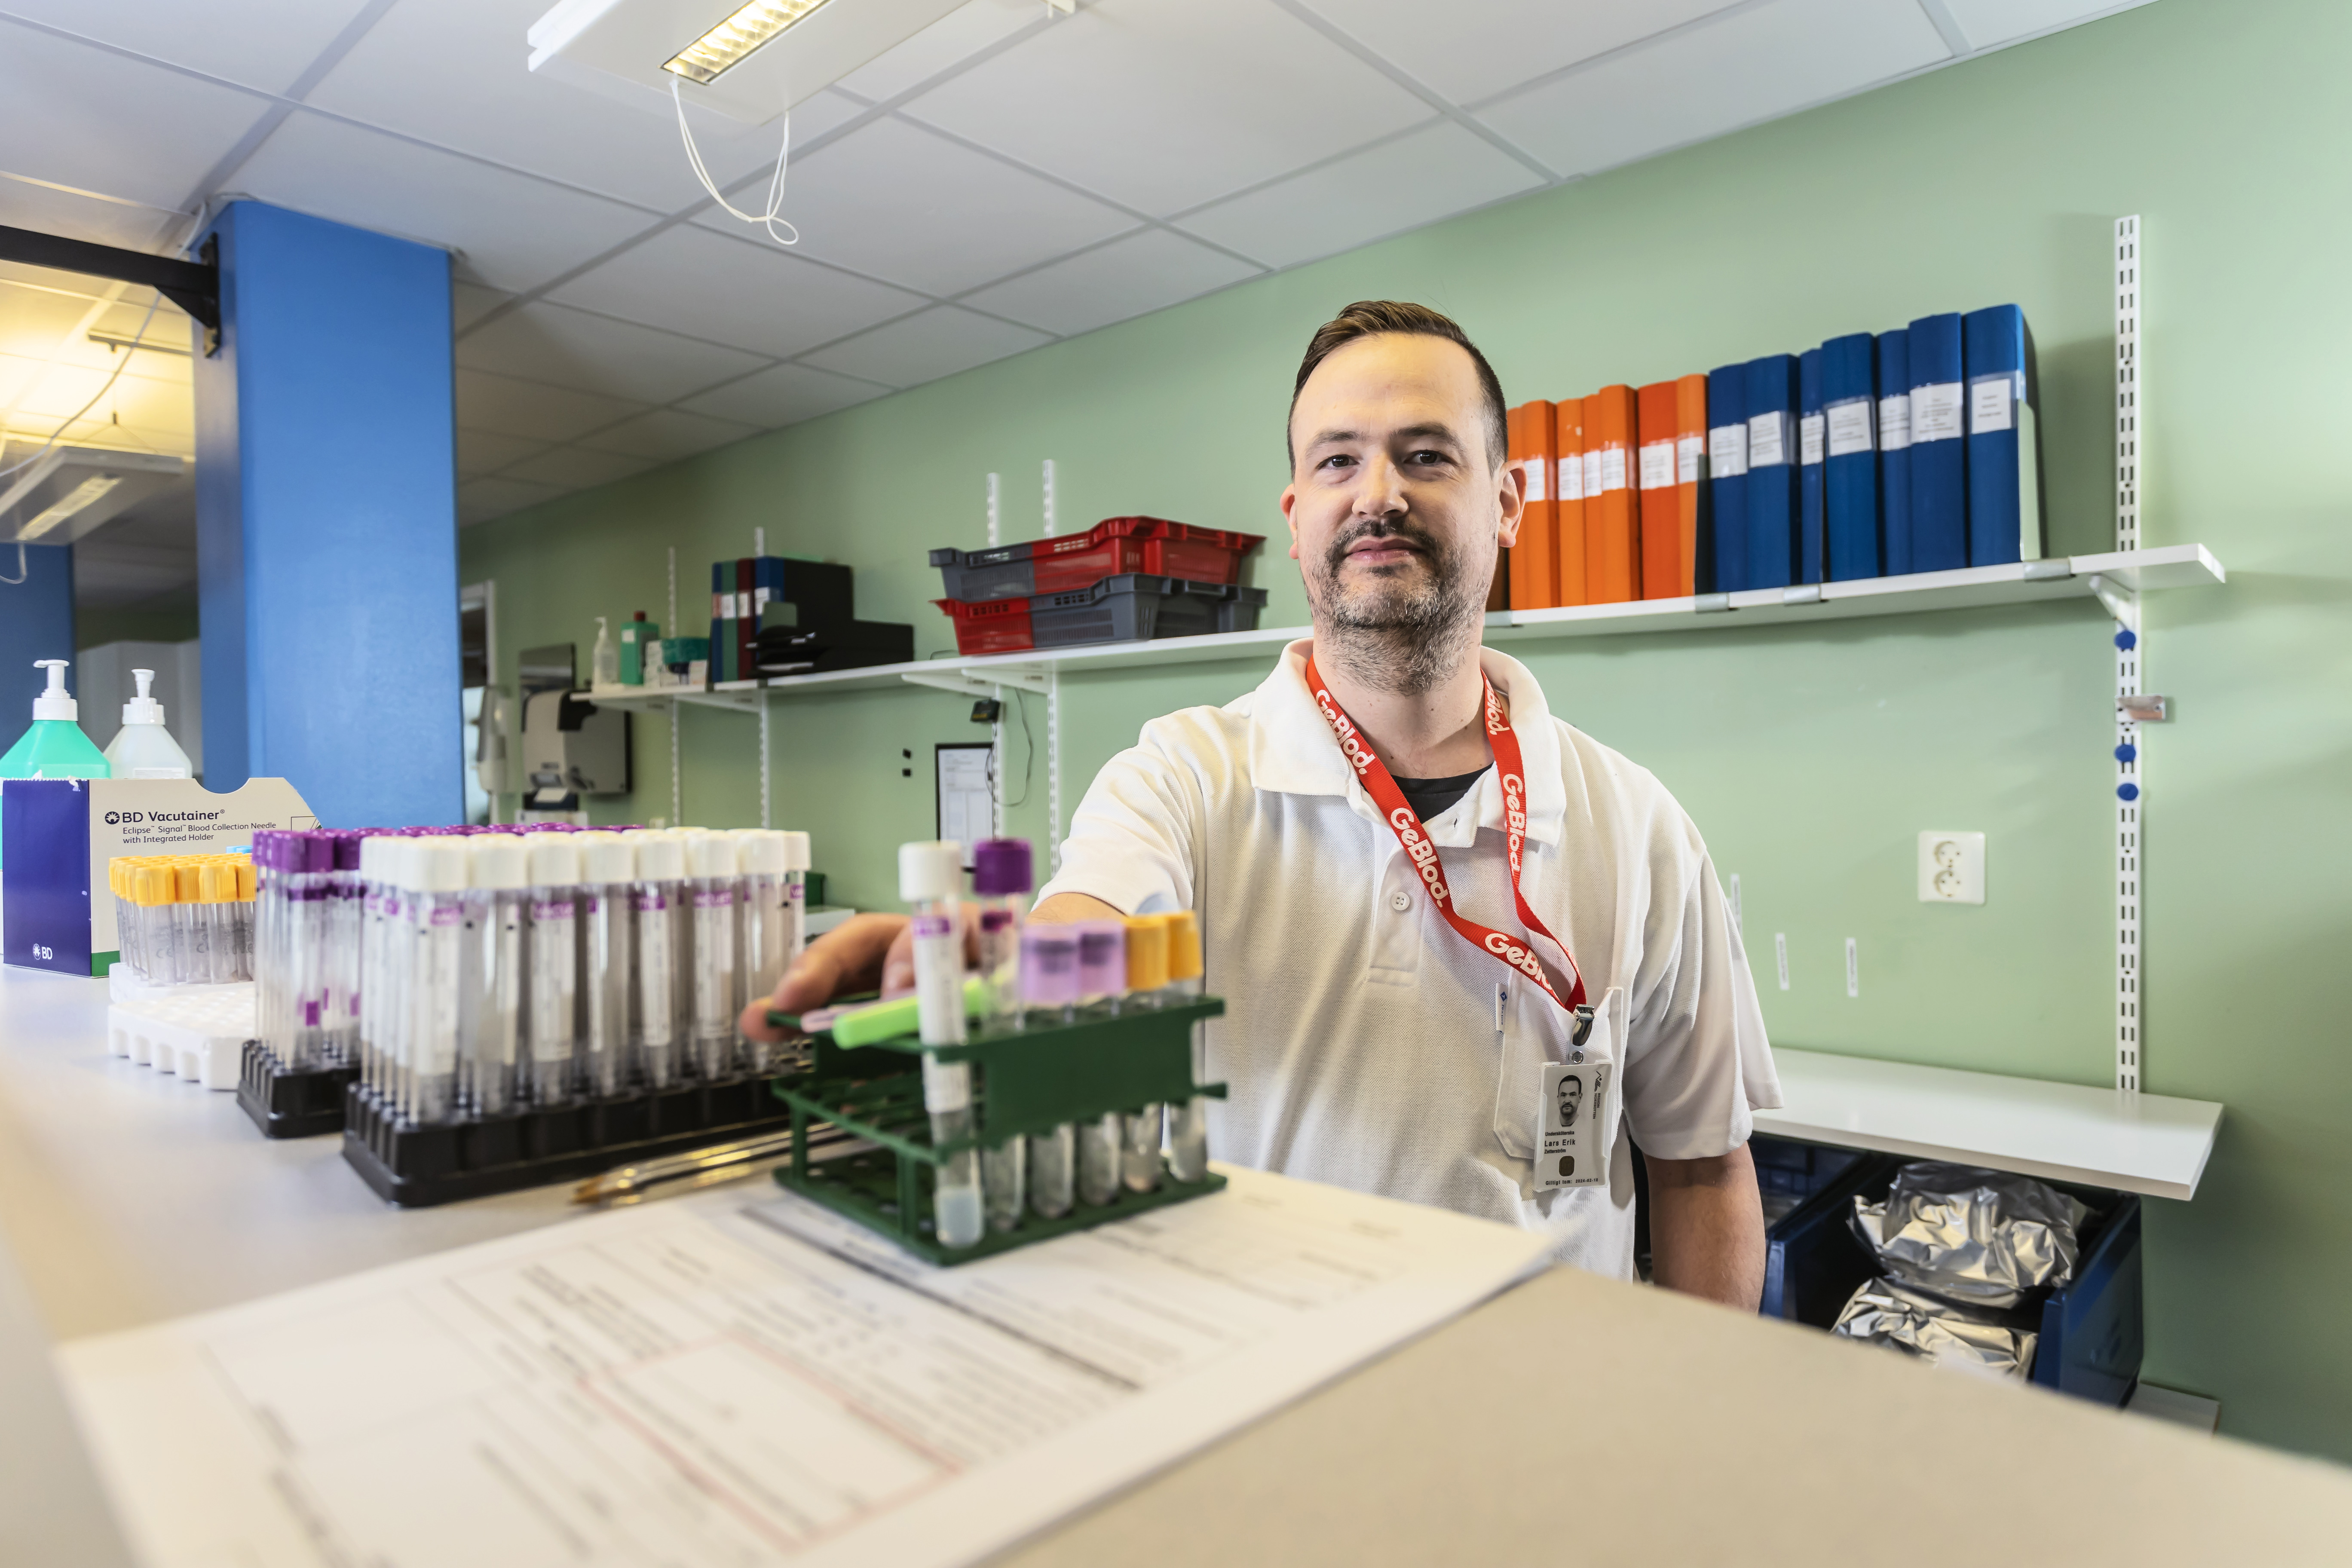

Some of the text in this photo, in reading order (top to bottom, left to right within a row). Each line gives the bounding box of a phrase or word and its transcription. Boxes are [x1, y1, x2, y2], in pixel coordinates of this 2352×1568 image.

[1316, 689, 1375, 775] GeBlod.
[122, 812, 143, 823] BD
[144, 834, 186, 844] Integrated
[1390, 808, 1448, 908] GeBlod.
[42, 946, 53, 960] BD
